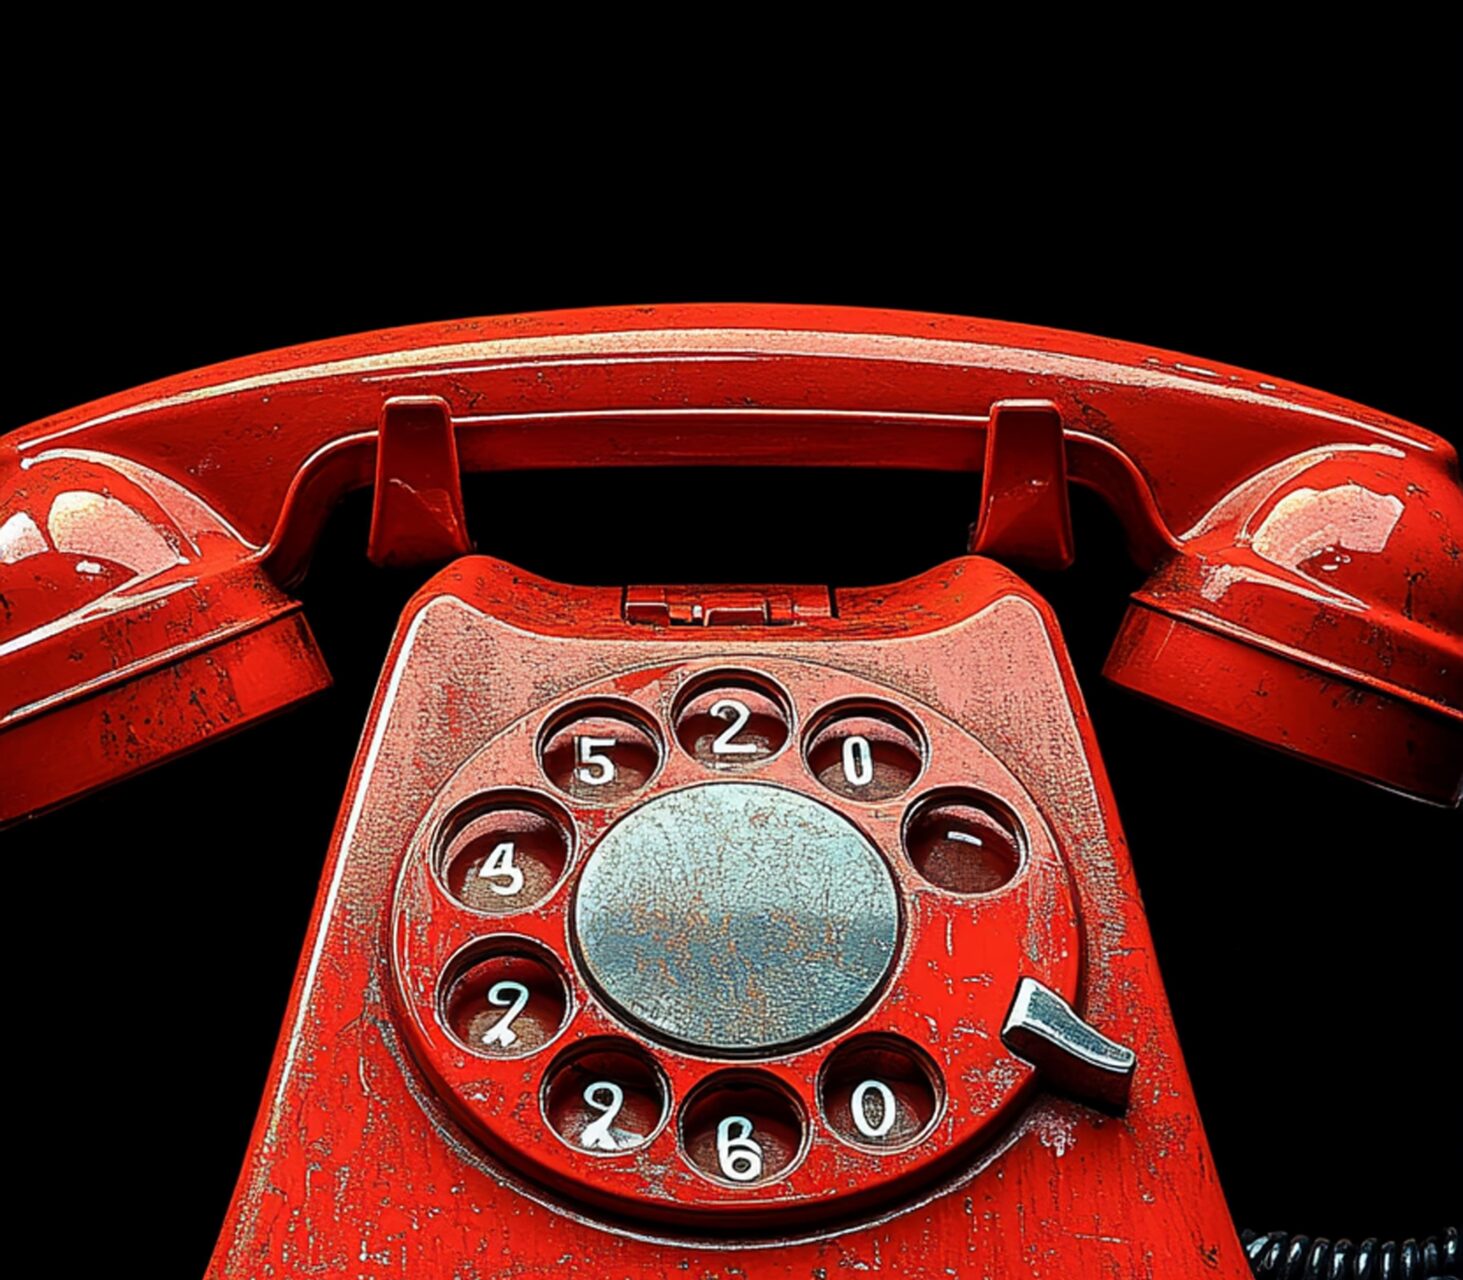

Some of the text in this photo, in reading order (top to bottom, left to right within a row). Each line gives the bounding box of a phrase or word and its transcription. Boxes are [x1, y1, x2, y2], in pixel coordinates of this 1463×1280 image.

[710, 700, 756, 754] 2
[577, 735, 616, 785] 5
[843, 736, 873, 786] 0
[851, 1080, 896, 1136] 0
